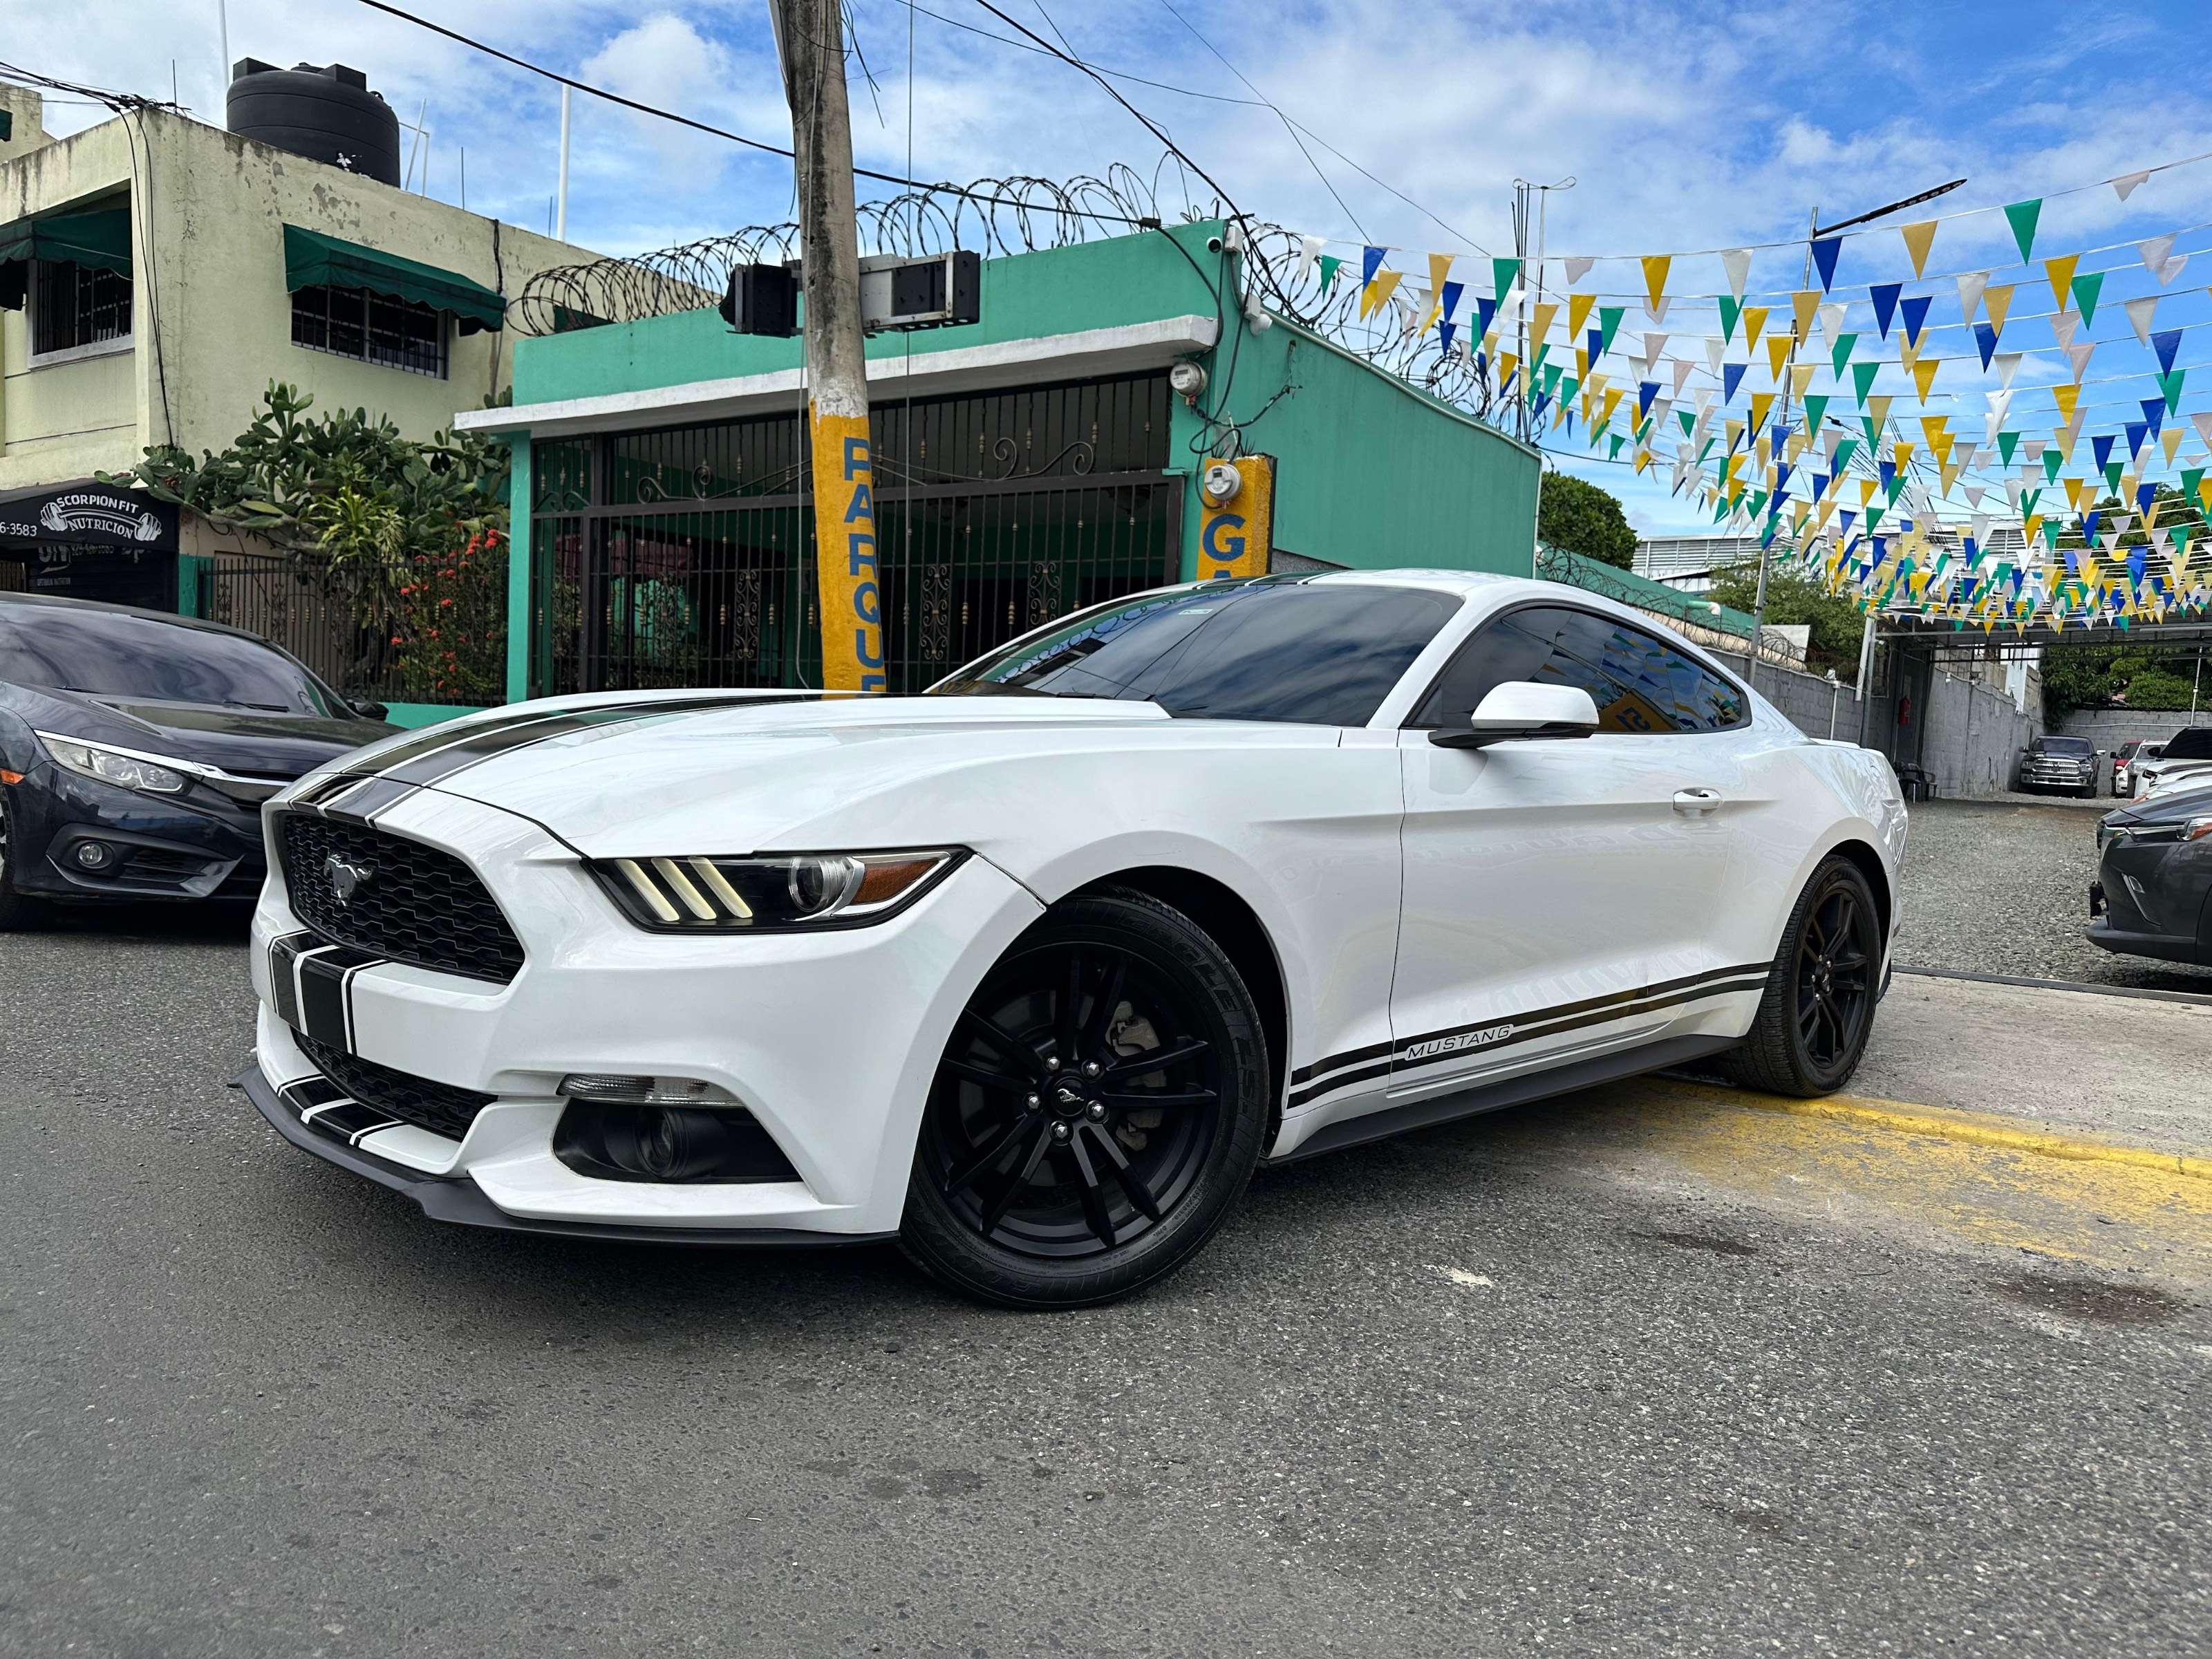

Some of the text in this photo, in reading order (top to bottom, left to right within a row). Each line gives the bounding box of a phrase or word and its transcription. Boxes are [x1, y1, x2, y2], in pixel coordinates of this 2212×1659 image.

[57, 495, 138, 514] SCORPION FIT
[0, 522, 37, 536] 6-3583
[68, 518, 134, 539] NUTRICION
[1203, 514, 1245, 579] G
[1407, 1025, 1510, 1059] MUSTANG
